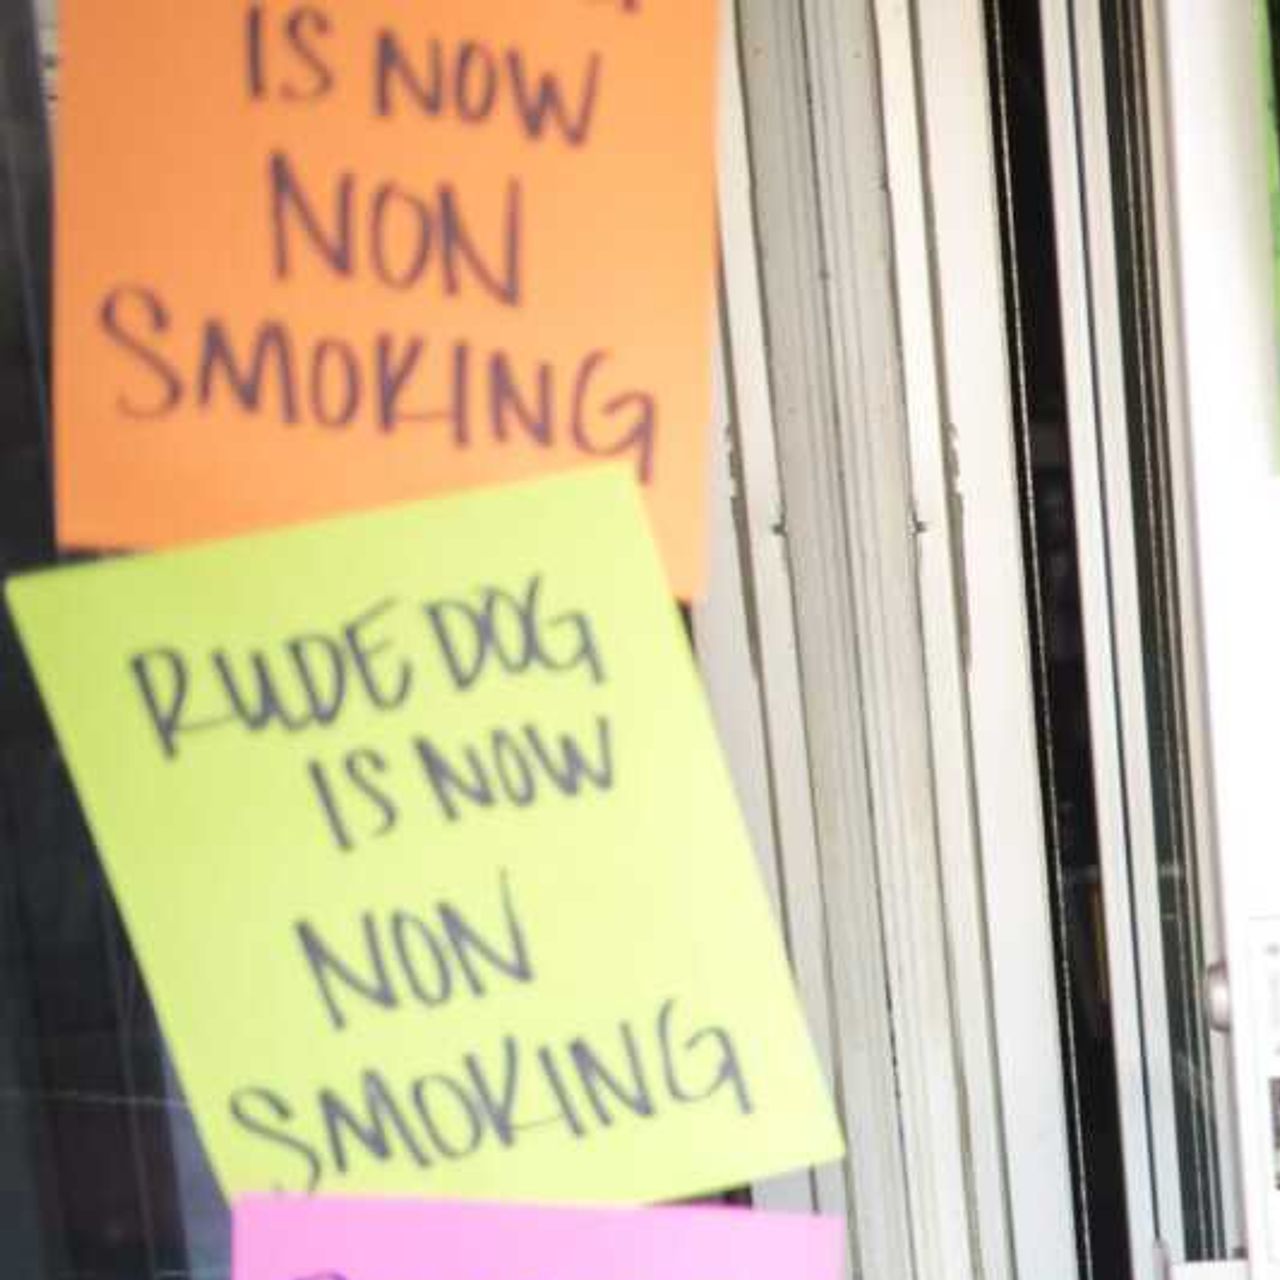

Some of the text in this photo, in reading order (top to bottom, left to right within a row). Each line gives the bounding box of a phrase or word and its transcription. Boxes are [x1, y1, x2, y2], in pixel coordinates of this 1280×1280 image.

[246, 2, 601, 147] IS NOW
[268, 150, 522, 309] NON
[99, 284, 658, 485] SMOKING
[128, 574, 606, 760] RUDE DOG
[309, 716, 616, 852] IS NOW
[295, 866, 535, 1031] NON
[228, 999, 754, 1195] SMOKING
